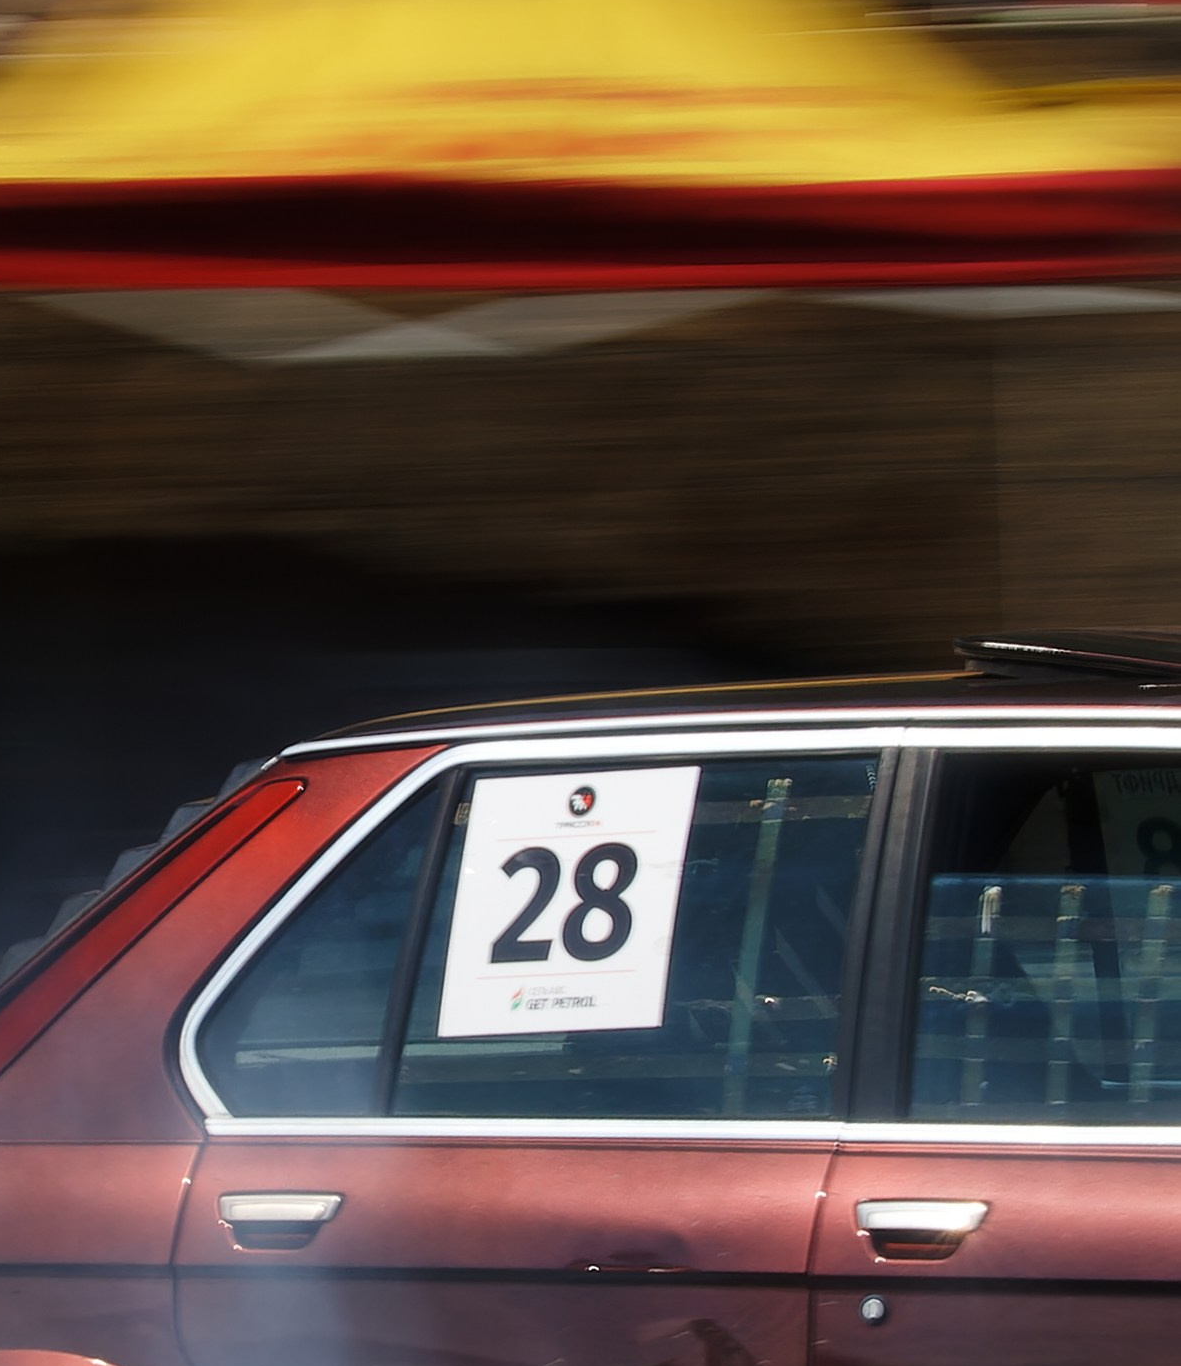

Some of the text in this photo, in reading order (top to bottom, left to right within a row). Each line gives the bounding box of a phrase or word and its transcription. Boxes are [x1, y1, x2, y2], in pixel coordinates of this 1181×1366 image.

[491, 842, 638, 963] 28
[526, 995, 597, 1010] GET PETROL
